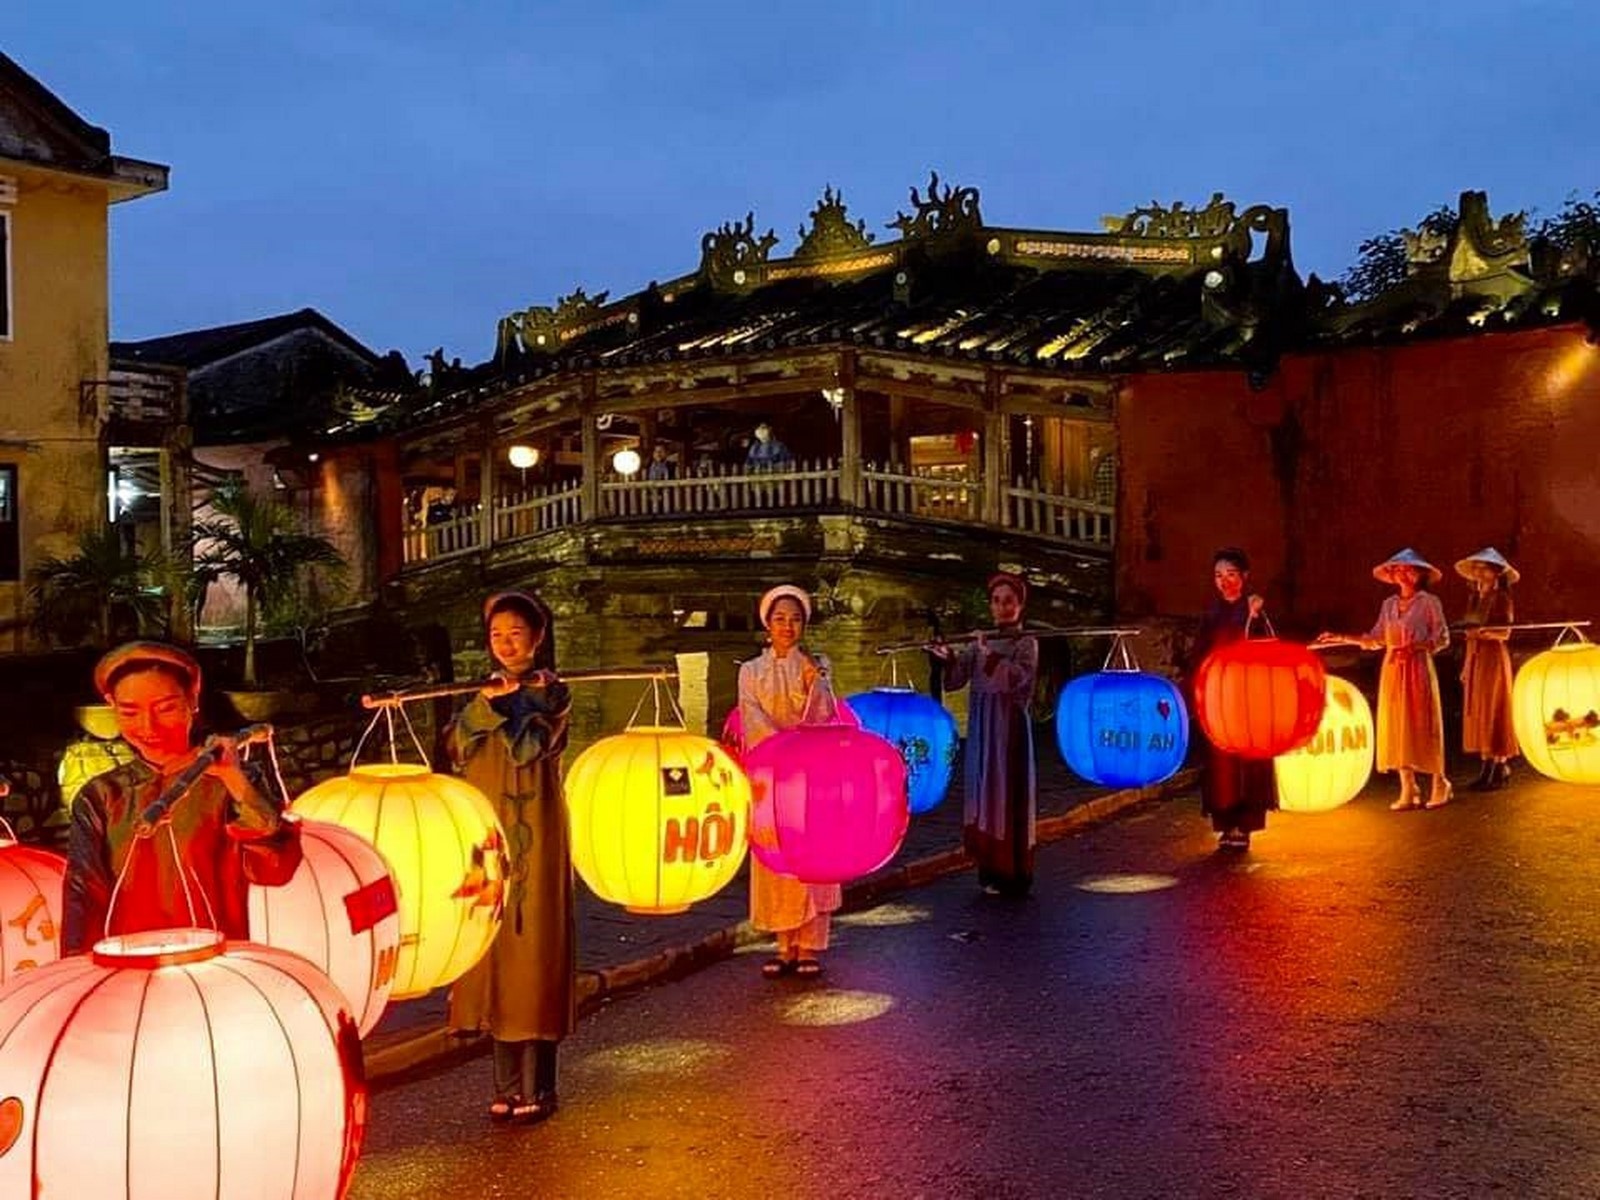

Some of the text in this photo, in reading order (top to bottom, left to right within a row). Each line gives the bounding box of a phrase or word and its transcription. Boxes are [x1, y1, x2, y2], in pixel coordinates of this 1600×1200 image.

[1147, 732, 1175, 752] AN
[1341, 724, 1367, 753] AN
[663, 802, 735, 868] HỘI
